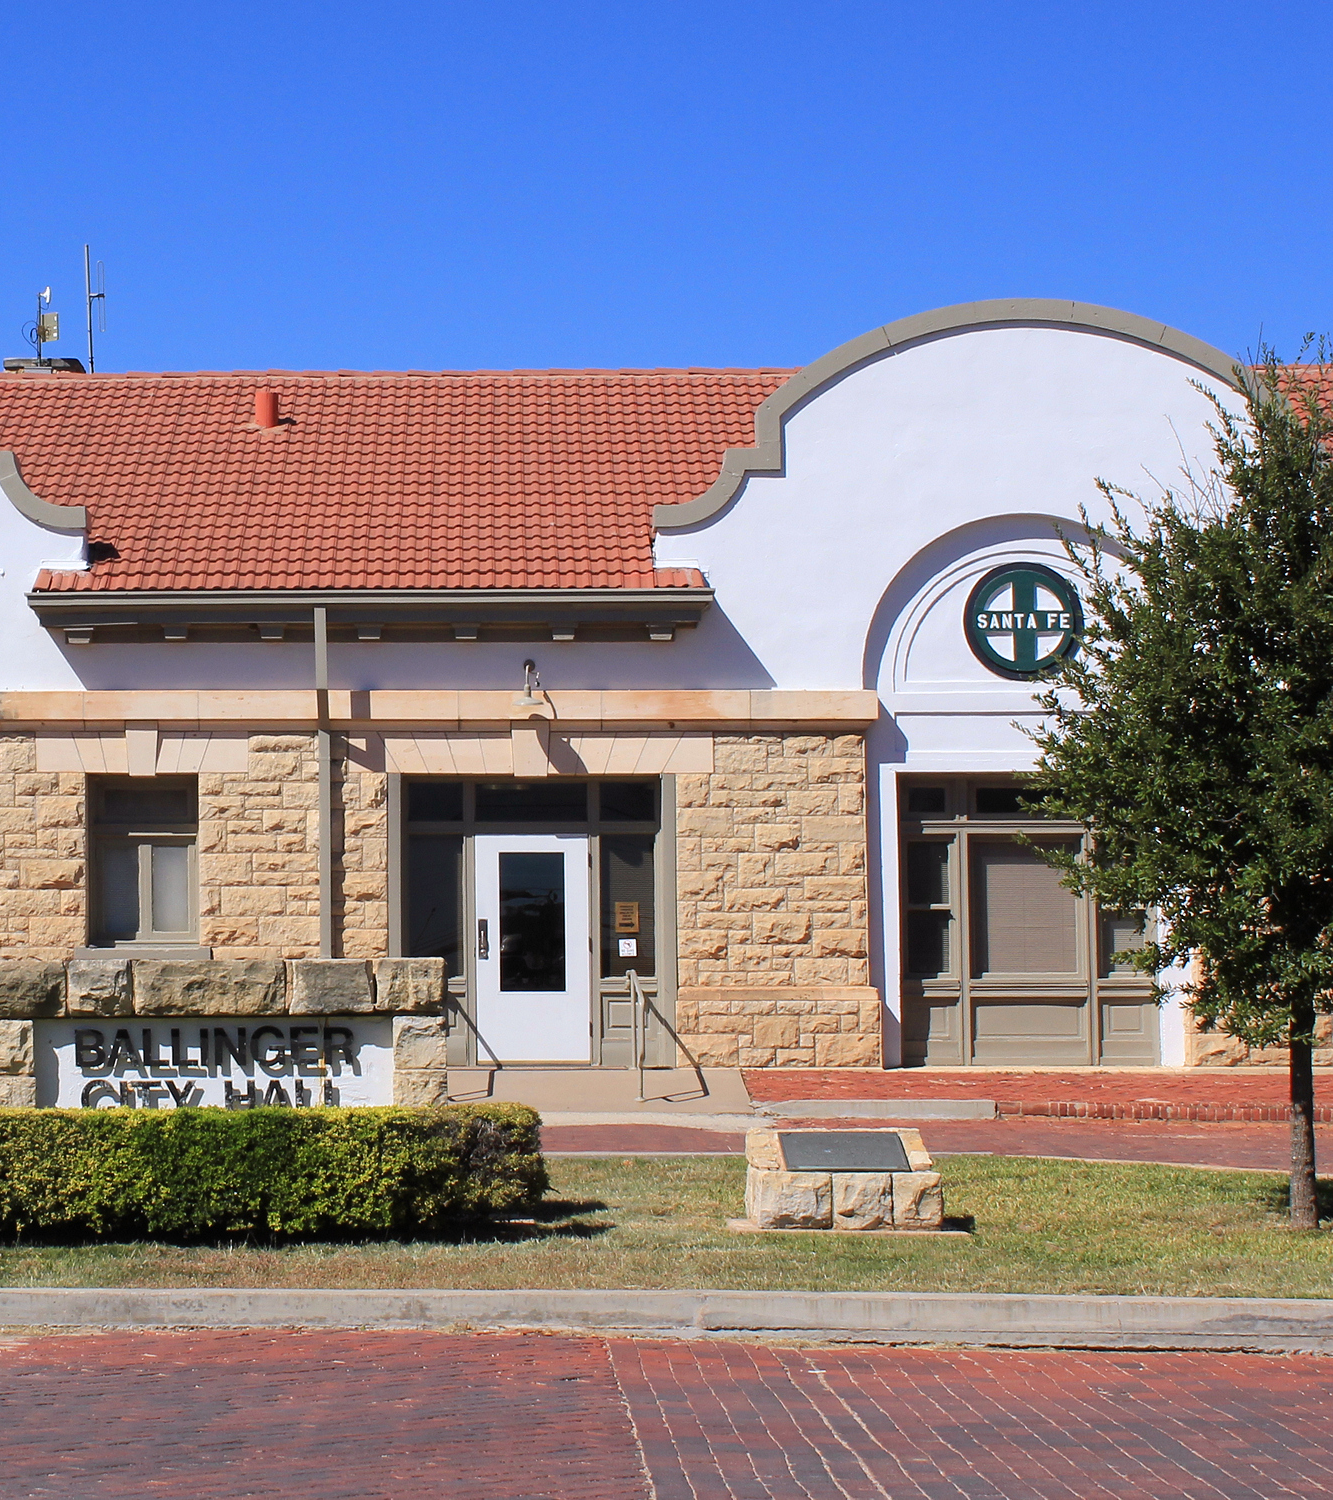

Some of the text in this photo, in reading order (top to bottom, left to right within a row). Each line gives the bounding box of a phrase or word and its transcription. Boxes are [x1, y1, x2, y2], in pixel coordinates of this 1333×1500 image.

[976, 612, 1071, 629] SANTA FE
[74, 1025, 354, 1068] BALLINGER
[81, 1079, 196, 1109] CITY
